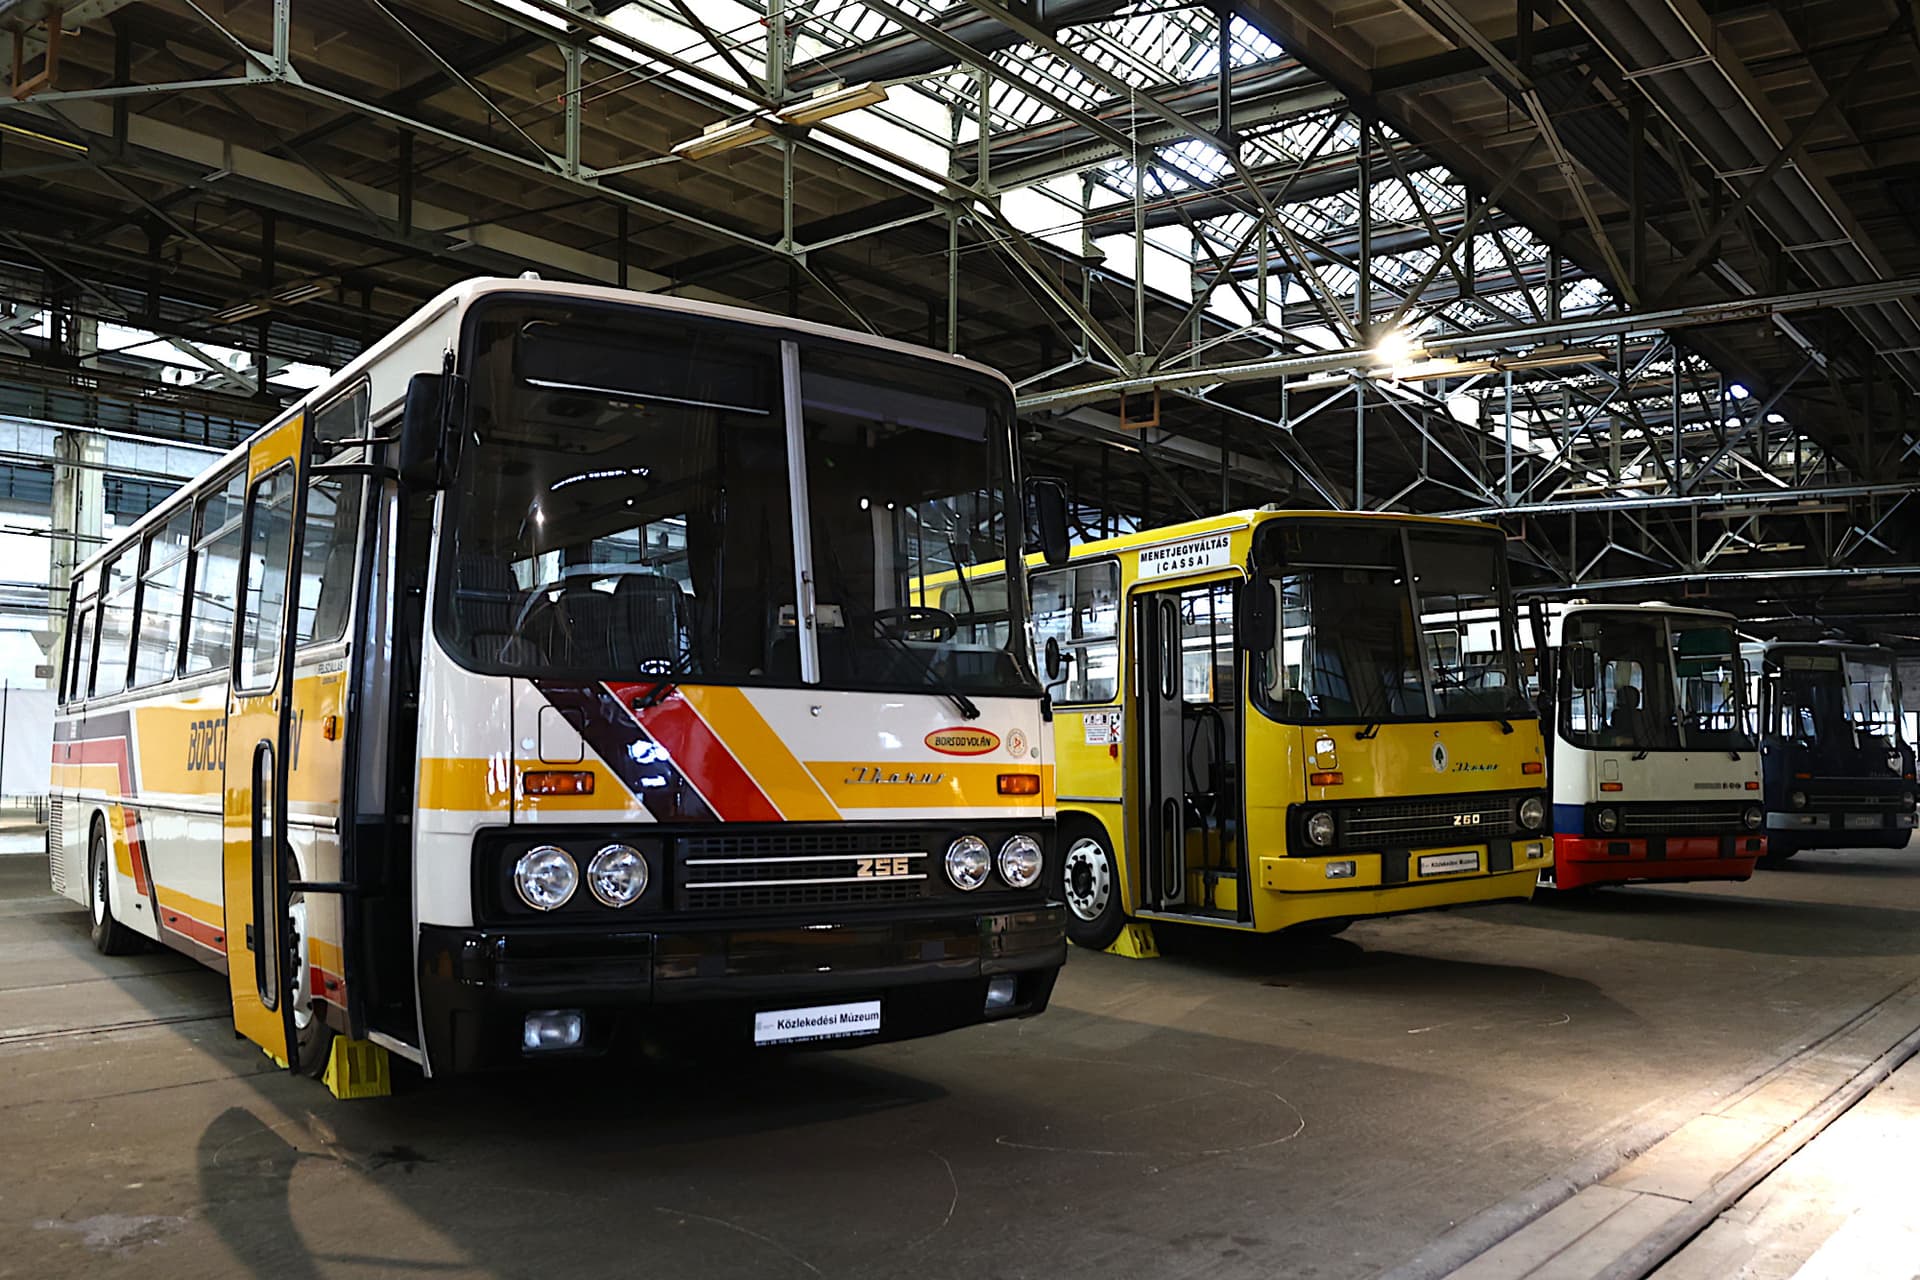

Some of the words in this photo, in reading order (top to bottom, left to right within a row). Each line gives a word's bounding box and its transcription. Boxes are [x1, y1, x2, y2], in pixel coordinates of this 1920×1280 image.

[1140, 536, 1229, 562] MENETJEGYVÁLTÁS
[844, 767, 947, 785] Ikarus
[1453, 814, 1480, 826] 260
[857, 857, 909, 878] 256
[777, 1013, 838, 1031] Közlekedési
[839, 1011, 880, 1024] Múzeum
